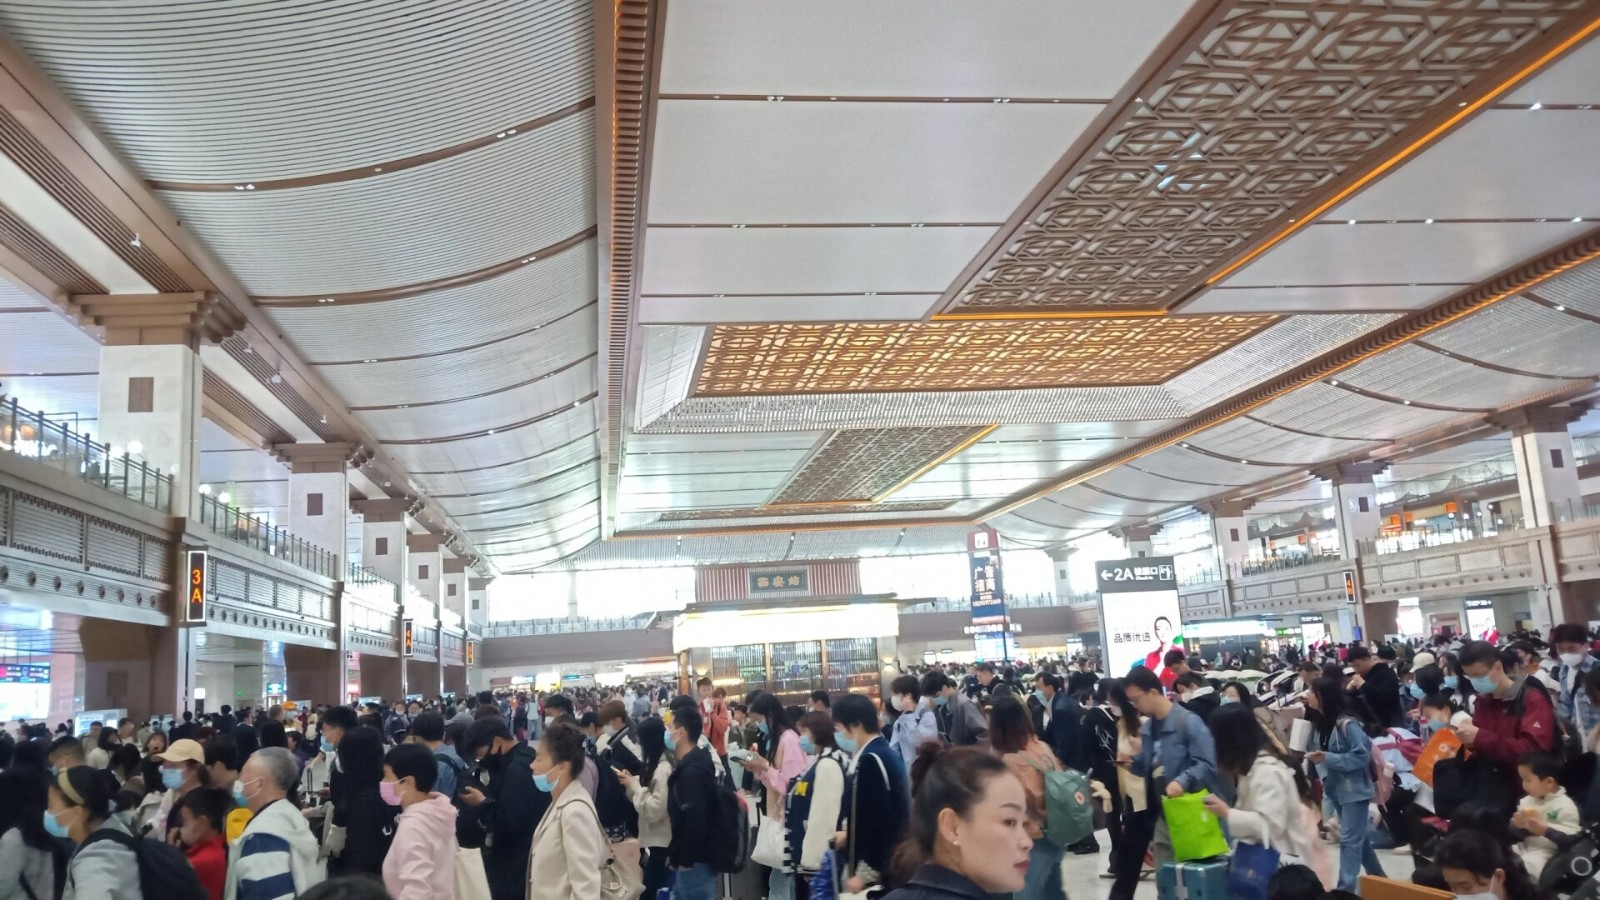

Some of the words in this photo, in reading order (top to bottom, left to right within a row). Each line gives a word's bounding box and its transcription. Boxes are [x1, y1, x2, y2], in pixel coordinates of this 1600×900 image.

[974, 565, 994, 580] 广告
[1113, 567, 1135, 581] 2A
[192, 569, 203, 603] 3A
[757, 575, 800, 588] 西安站
[974, 579, 996, 592] 招商
[1114, 632, 1151, 643] 品质优选
